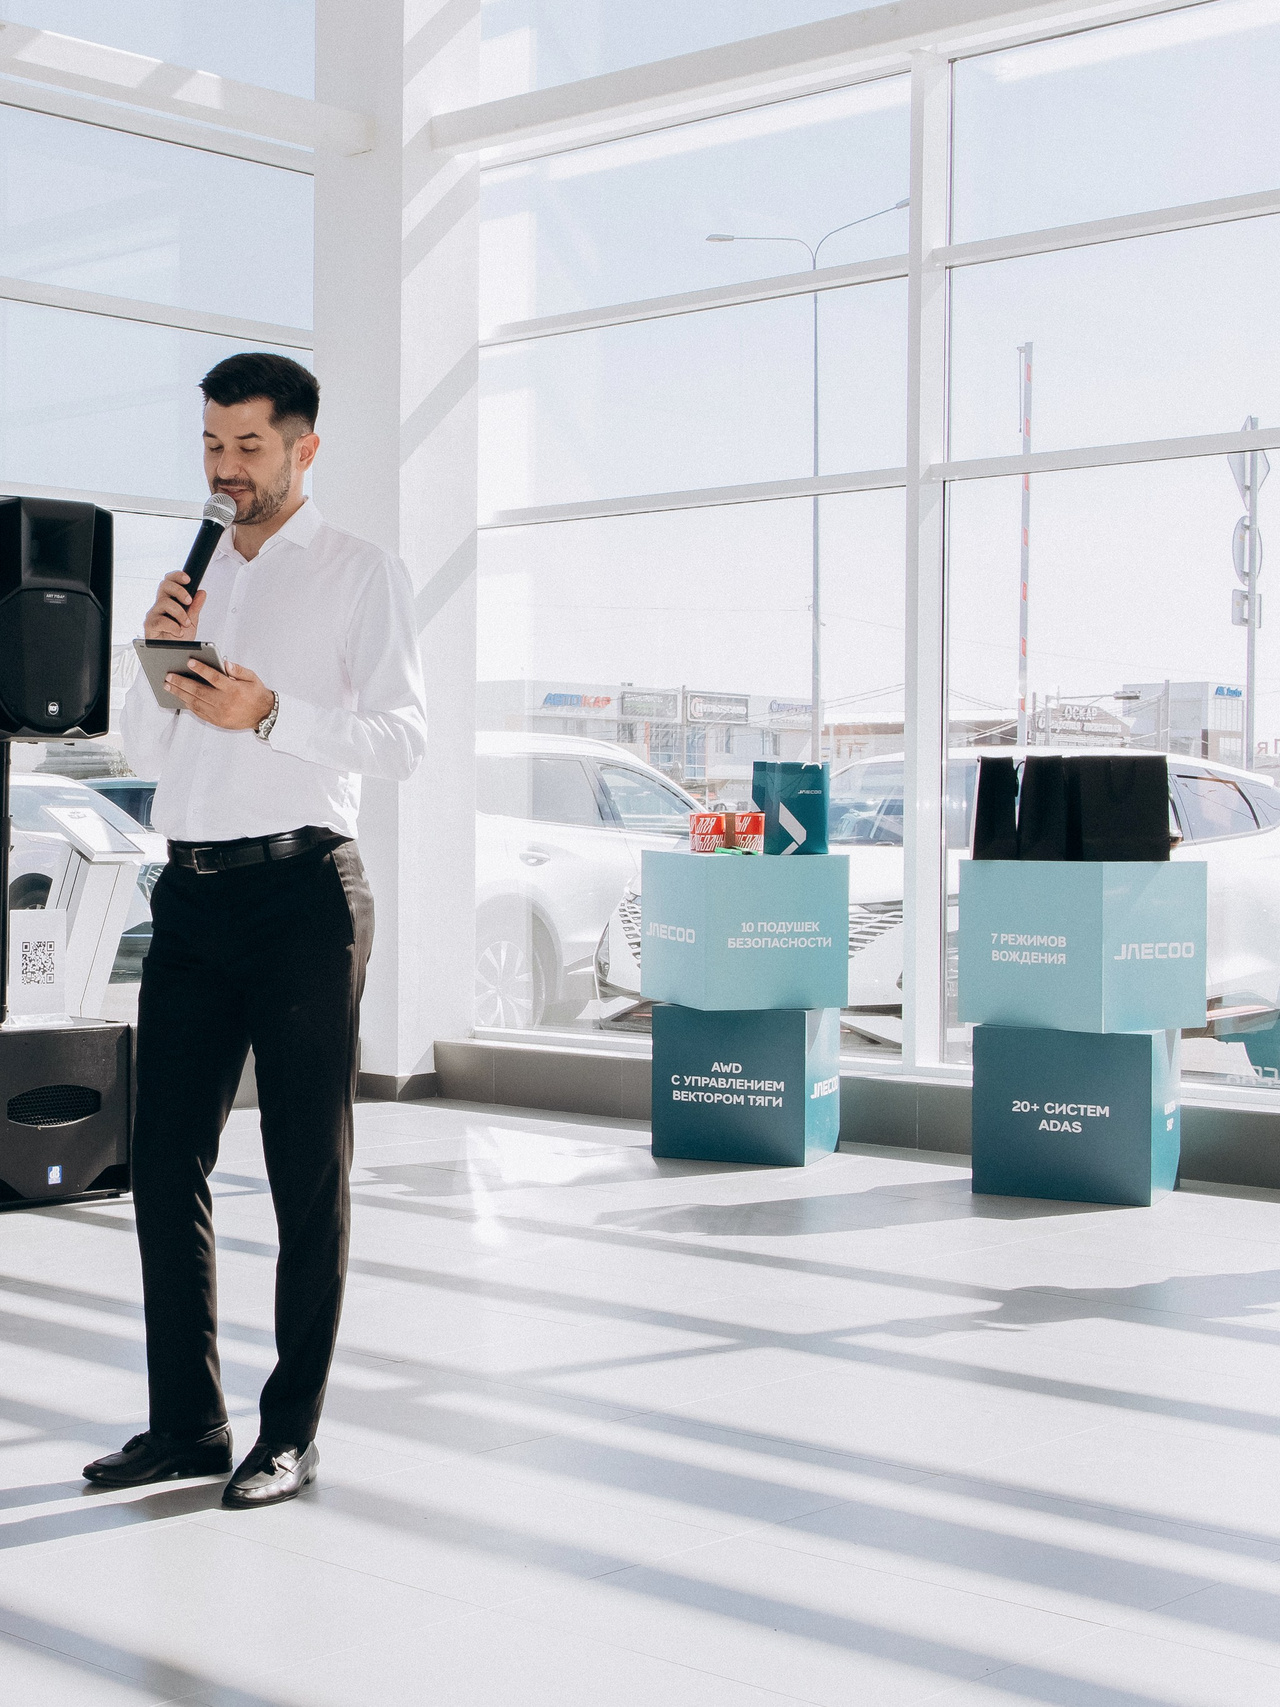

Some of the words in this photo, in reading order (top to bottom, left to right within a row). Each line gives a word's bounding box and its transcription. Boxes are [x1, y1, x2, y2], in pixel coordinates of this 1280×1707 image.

[646, 921, 696, 944] JAECOO
[740, 922, 755, 933] 10
[757, 921, 820, 935] ПОДУШЕК
[727, 937, 832, 949] БЕЗОПАСНОСТИ
[991, 933, 999, 945] 7
[1000, 934, 1067, 948] РЕЖИМОВ
[991, 950, 1067, 965] ВОЖДЕНИЯ
[1113, 942, 1195, 960] JAECOO
[711, 1062, 742, 1074] AWD
[671, 1075, 681, 1085] С
[683, 1075, 785, 1092] УПРАВЛЕНИЕМ
[672, 1090, 745, 1105] ВЕКТОРОМ
[747, 1095, 783, 1107] ТЯГИ
[1011, 1100, 1040, 1113] 20+
[1043, 1102, 1110, 1118] СИСТЕМ
[1038, 1119, 1082, 1133] ADAS
